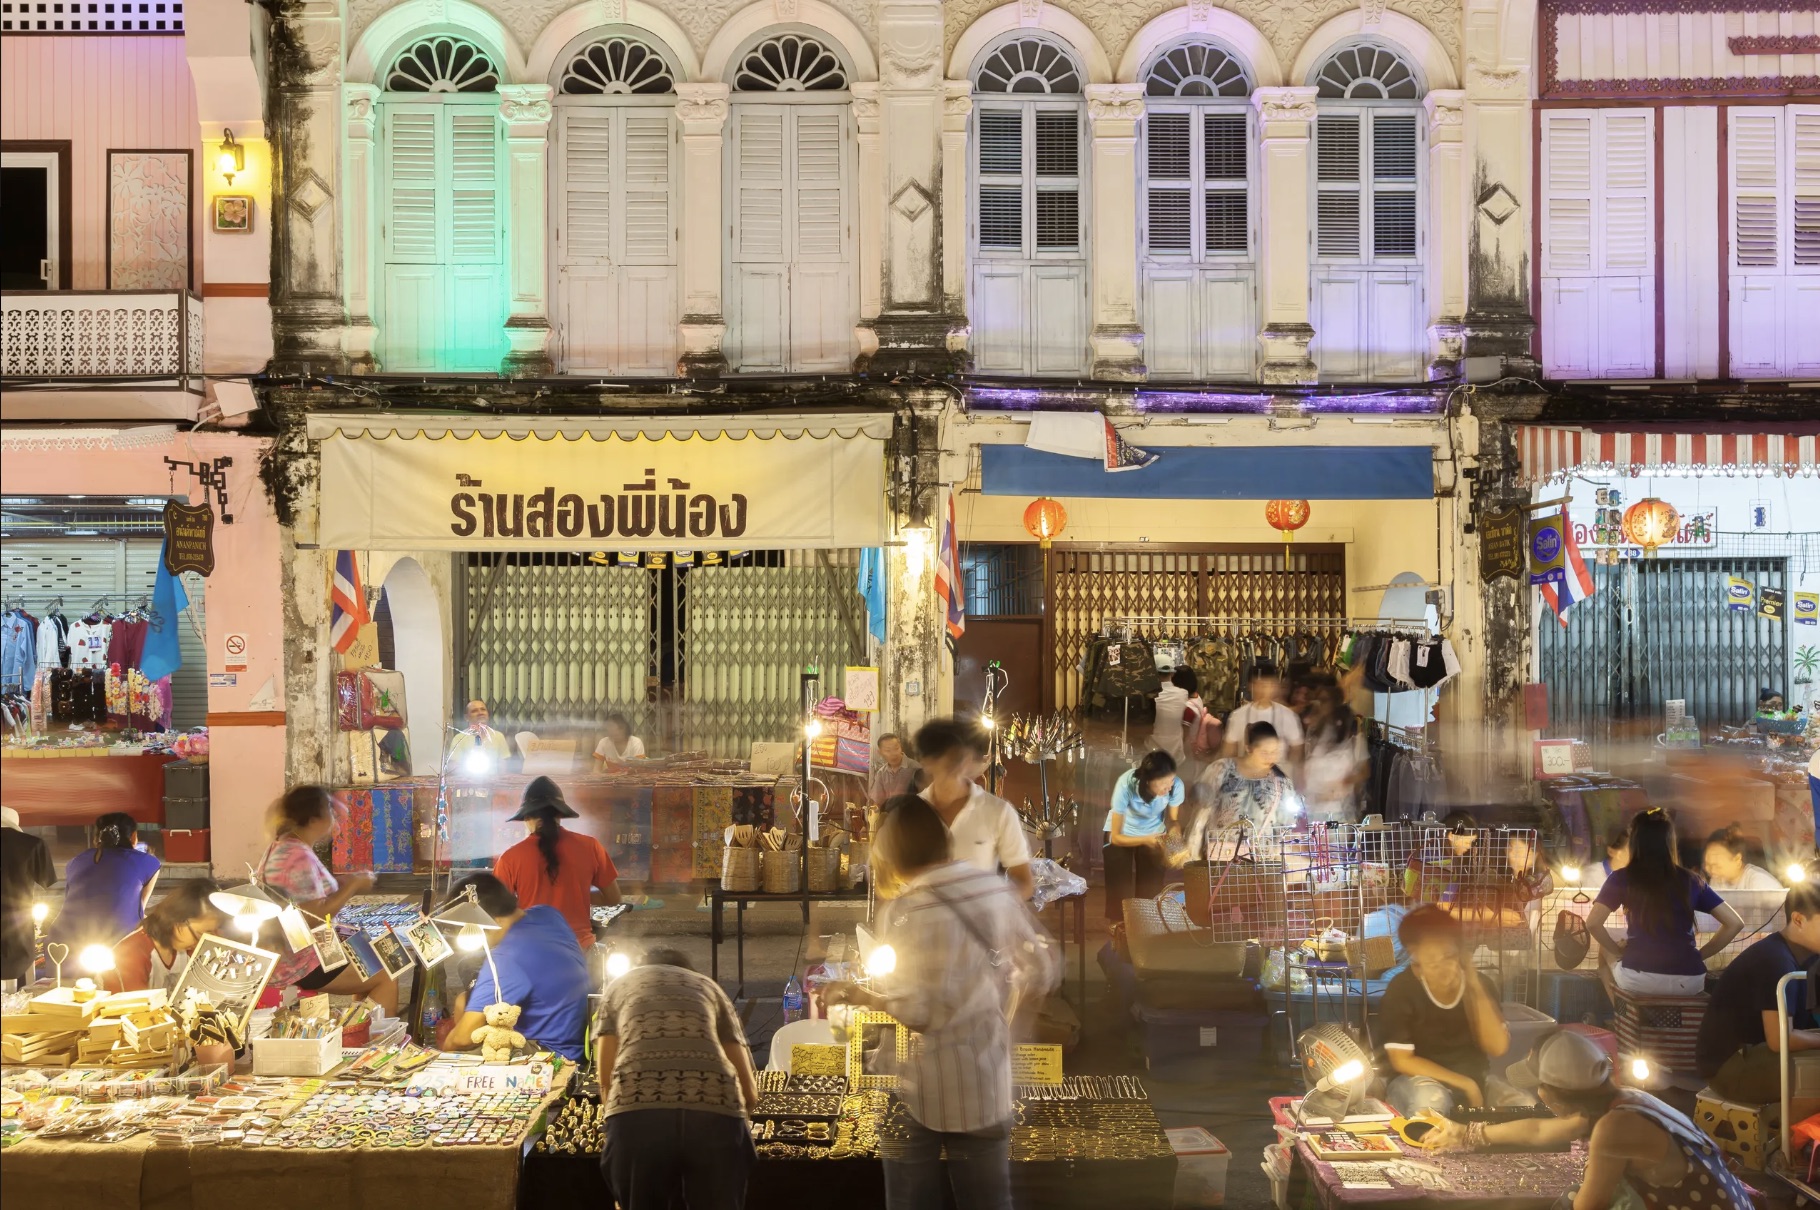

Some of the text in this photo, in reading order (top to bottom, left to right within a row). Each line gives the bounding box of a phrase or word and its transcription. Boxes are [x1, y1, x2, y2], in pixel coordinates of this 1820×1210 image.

[451, 468, 748, 538] ร้านสองพี่น้อง
[466, 1076, 496, 1089] FREE
